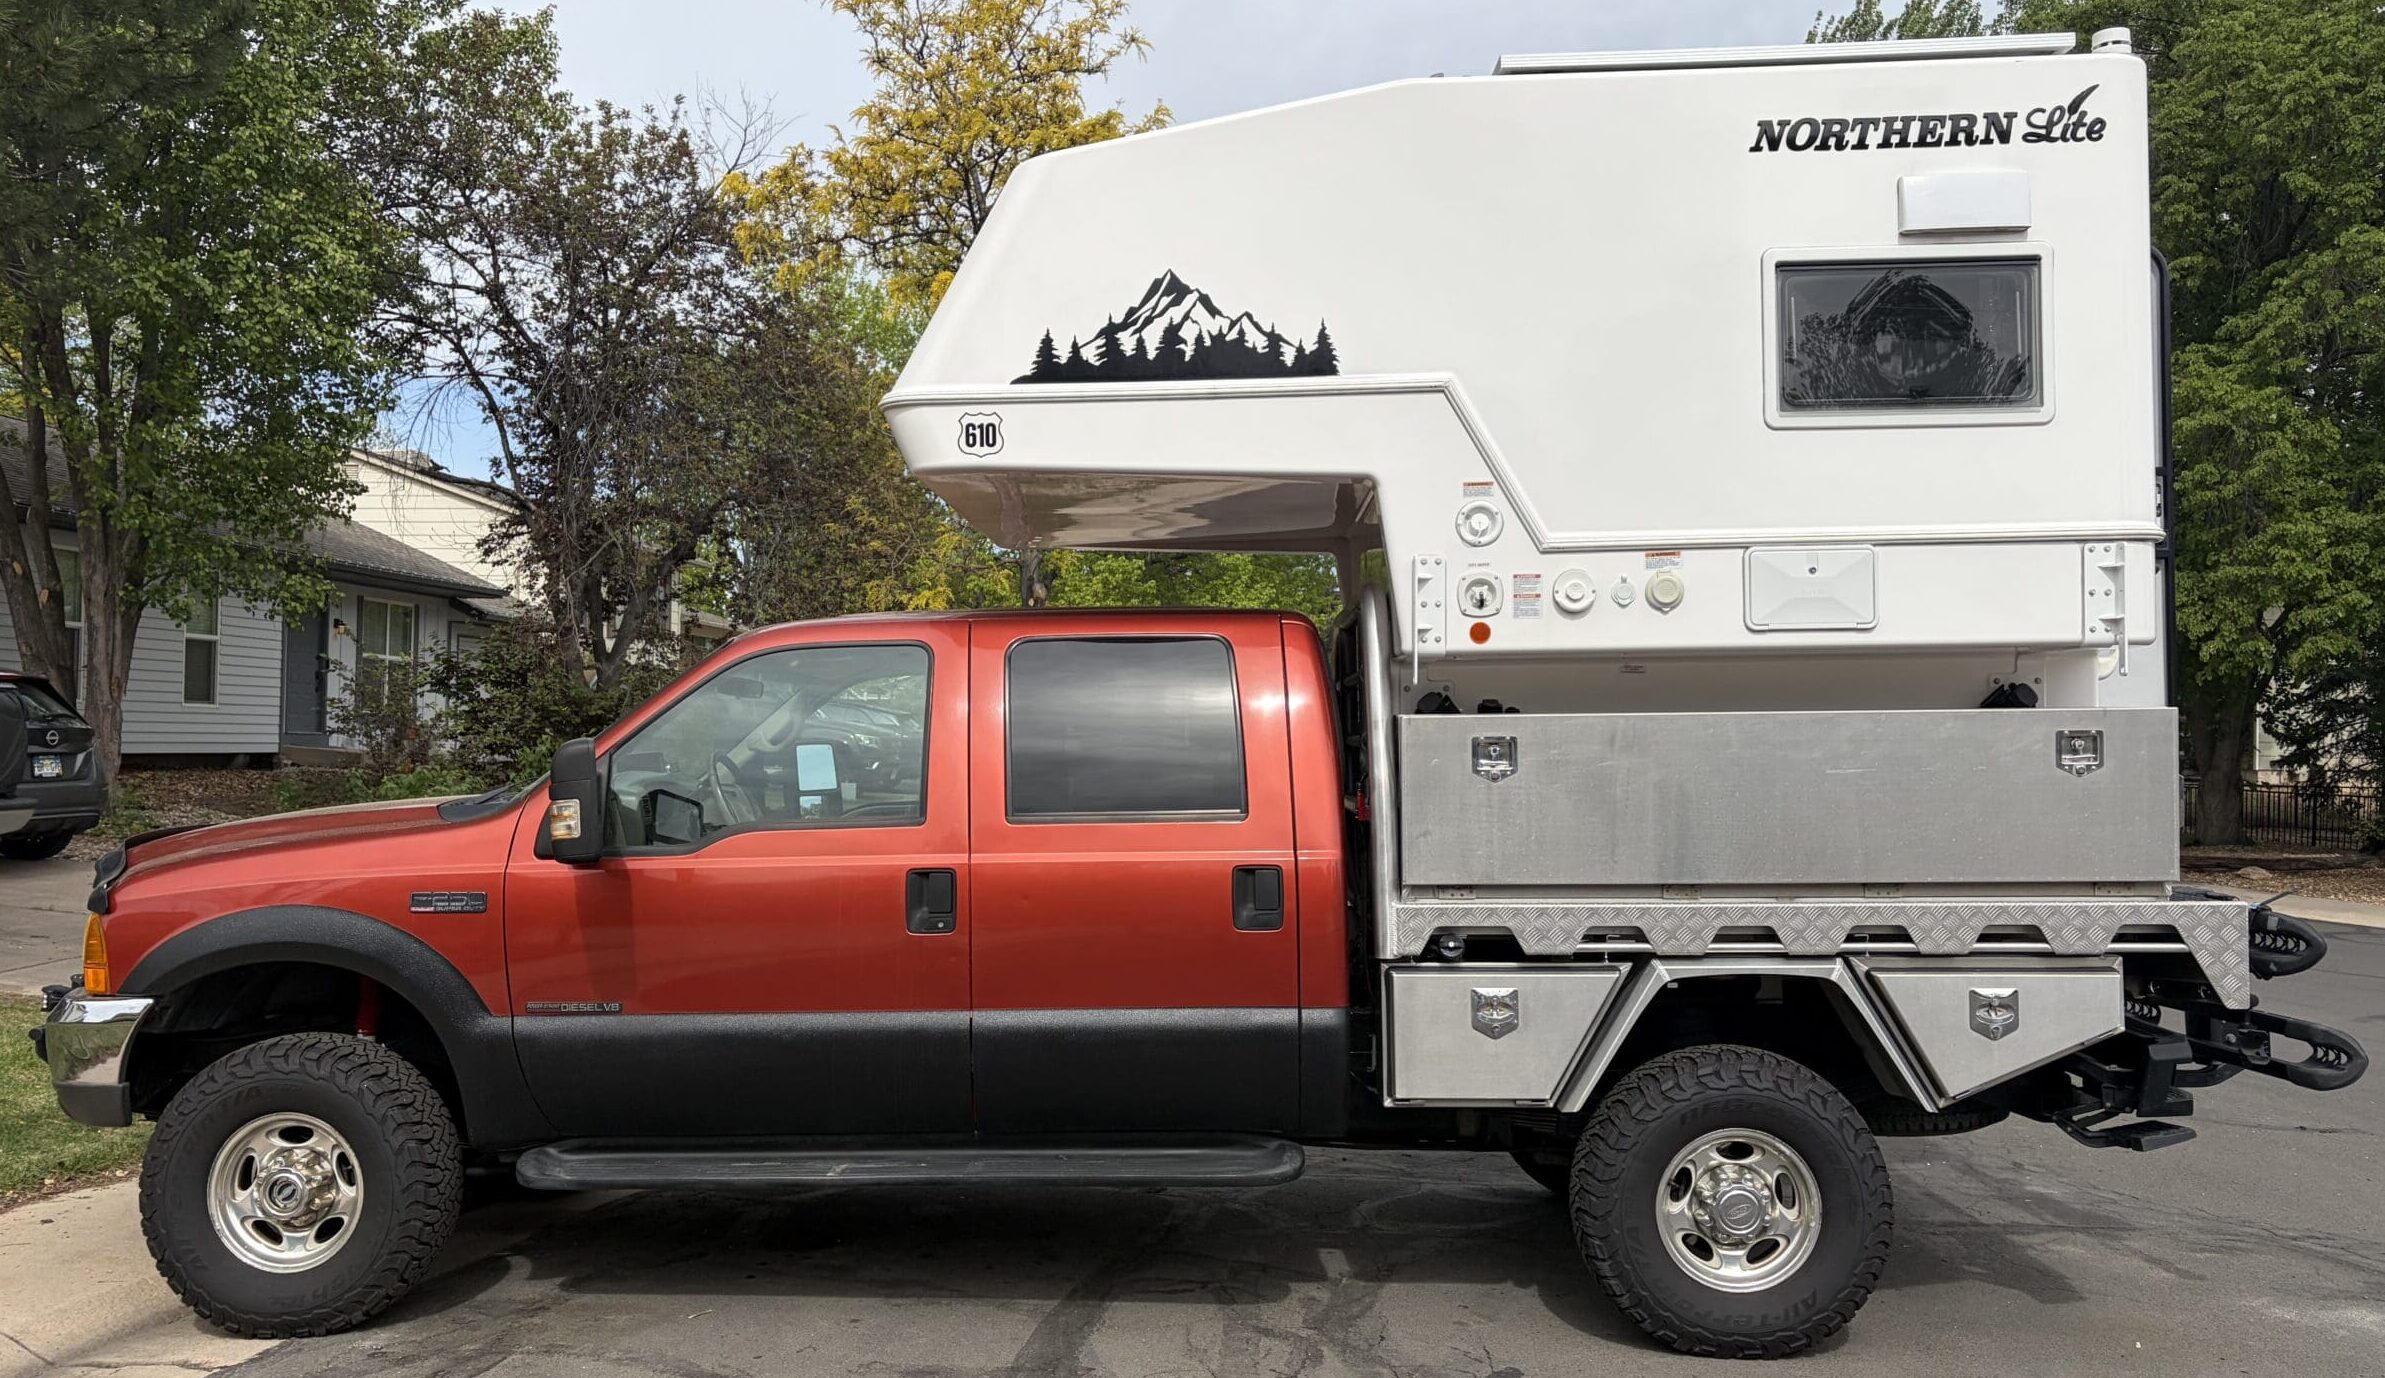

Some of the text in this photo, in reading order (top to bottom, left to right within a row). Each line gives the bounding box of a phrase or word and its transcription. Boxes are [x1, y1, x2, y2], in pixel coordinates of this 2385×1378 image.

[1749, 83, 2107, 153] NORTHERN Lite
[965, 422, 997, 448] 610
[560, 1003, 603, 1012] DIESEL
[603, 1003, 620, 1012] V8
